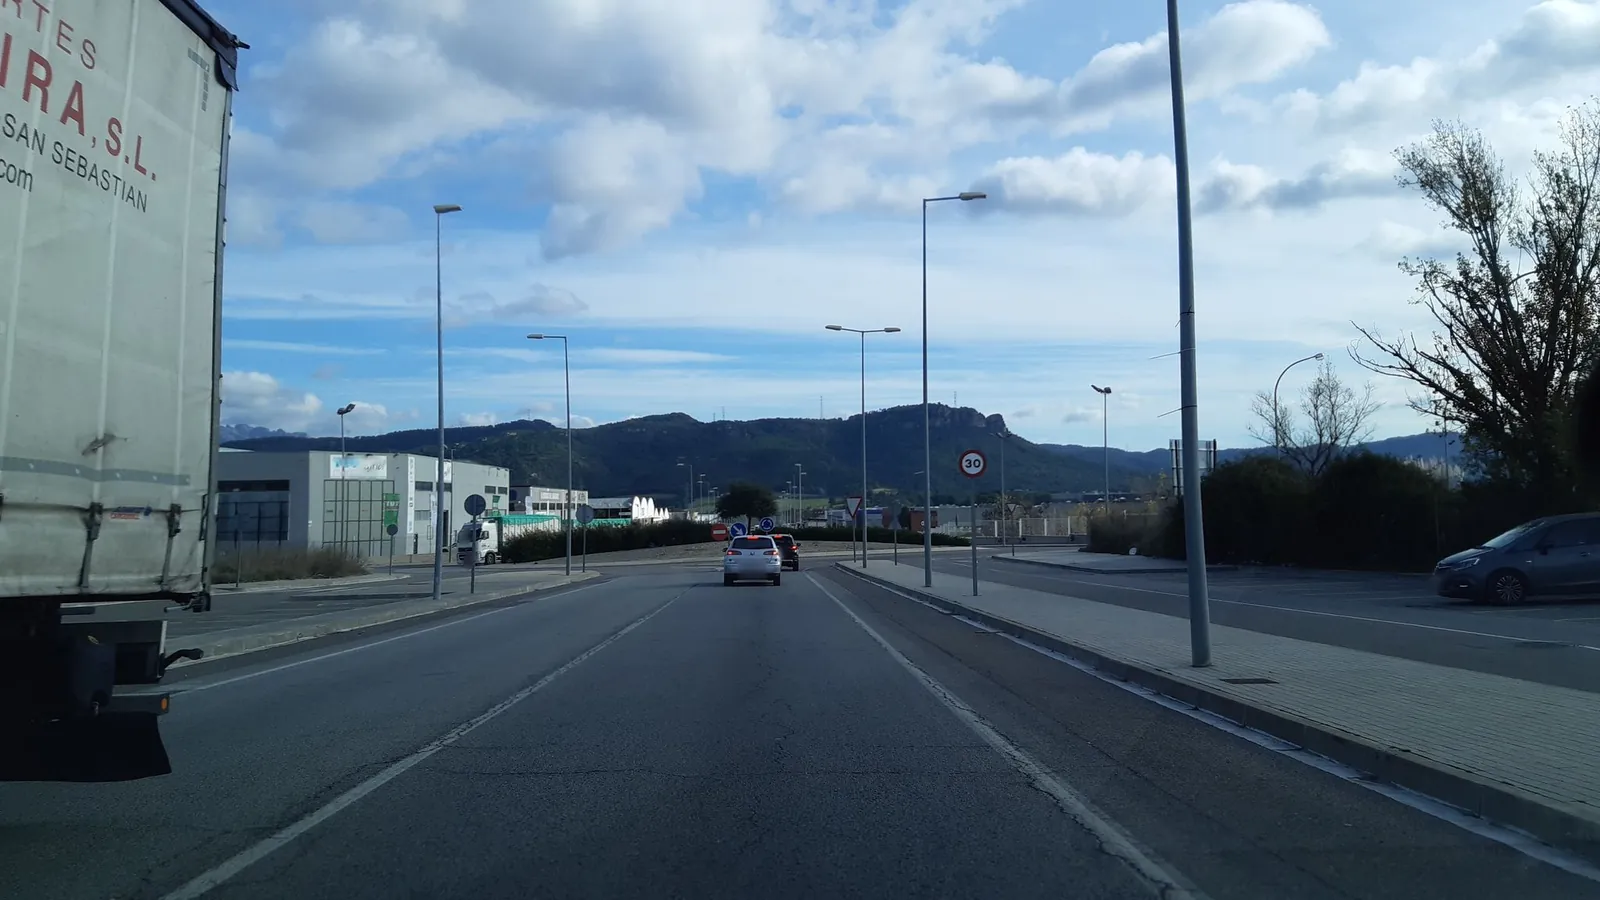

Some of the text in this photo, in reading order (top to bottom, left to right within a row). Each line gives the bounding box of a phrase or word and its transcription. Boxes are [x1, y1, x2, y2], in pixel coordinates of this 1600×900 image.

[2, 113, 147, 213] SAN SEBASTIAN
[965, 459, 981, 468] 30
